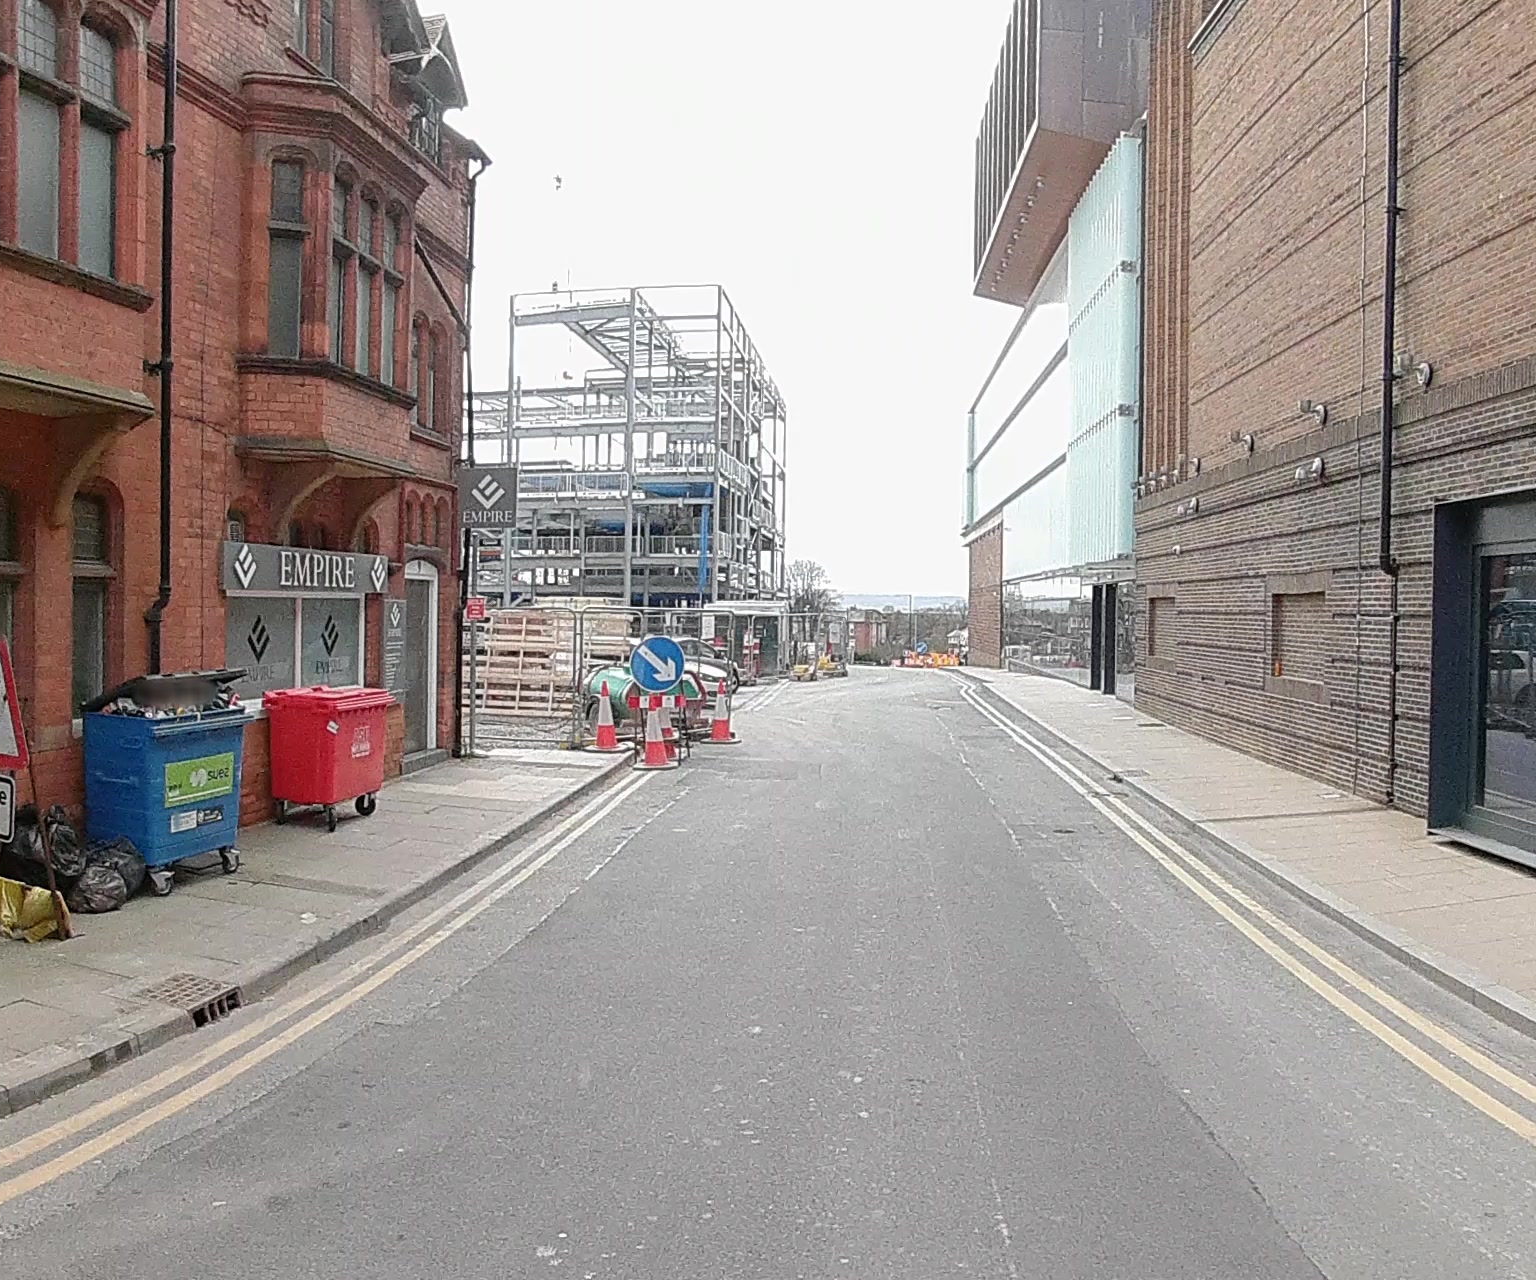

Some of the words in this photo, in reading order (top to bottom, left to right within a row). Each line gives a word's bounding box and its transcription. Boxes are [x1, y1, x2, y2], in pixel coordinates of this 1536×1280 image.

[463, 510, 513, 523] EMPIRE
[280, 551, 356, 588] EMPIRE
[207, 767, 230, 781] suez
